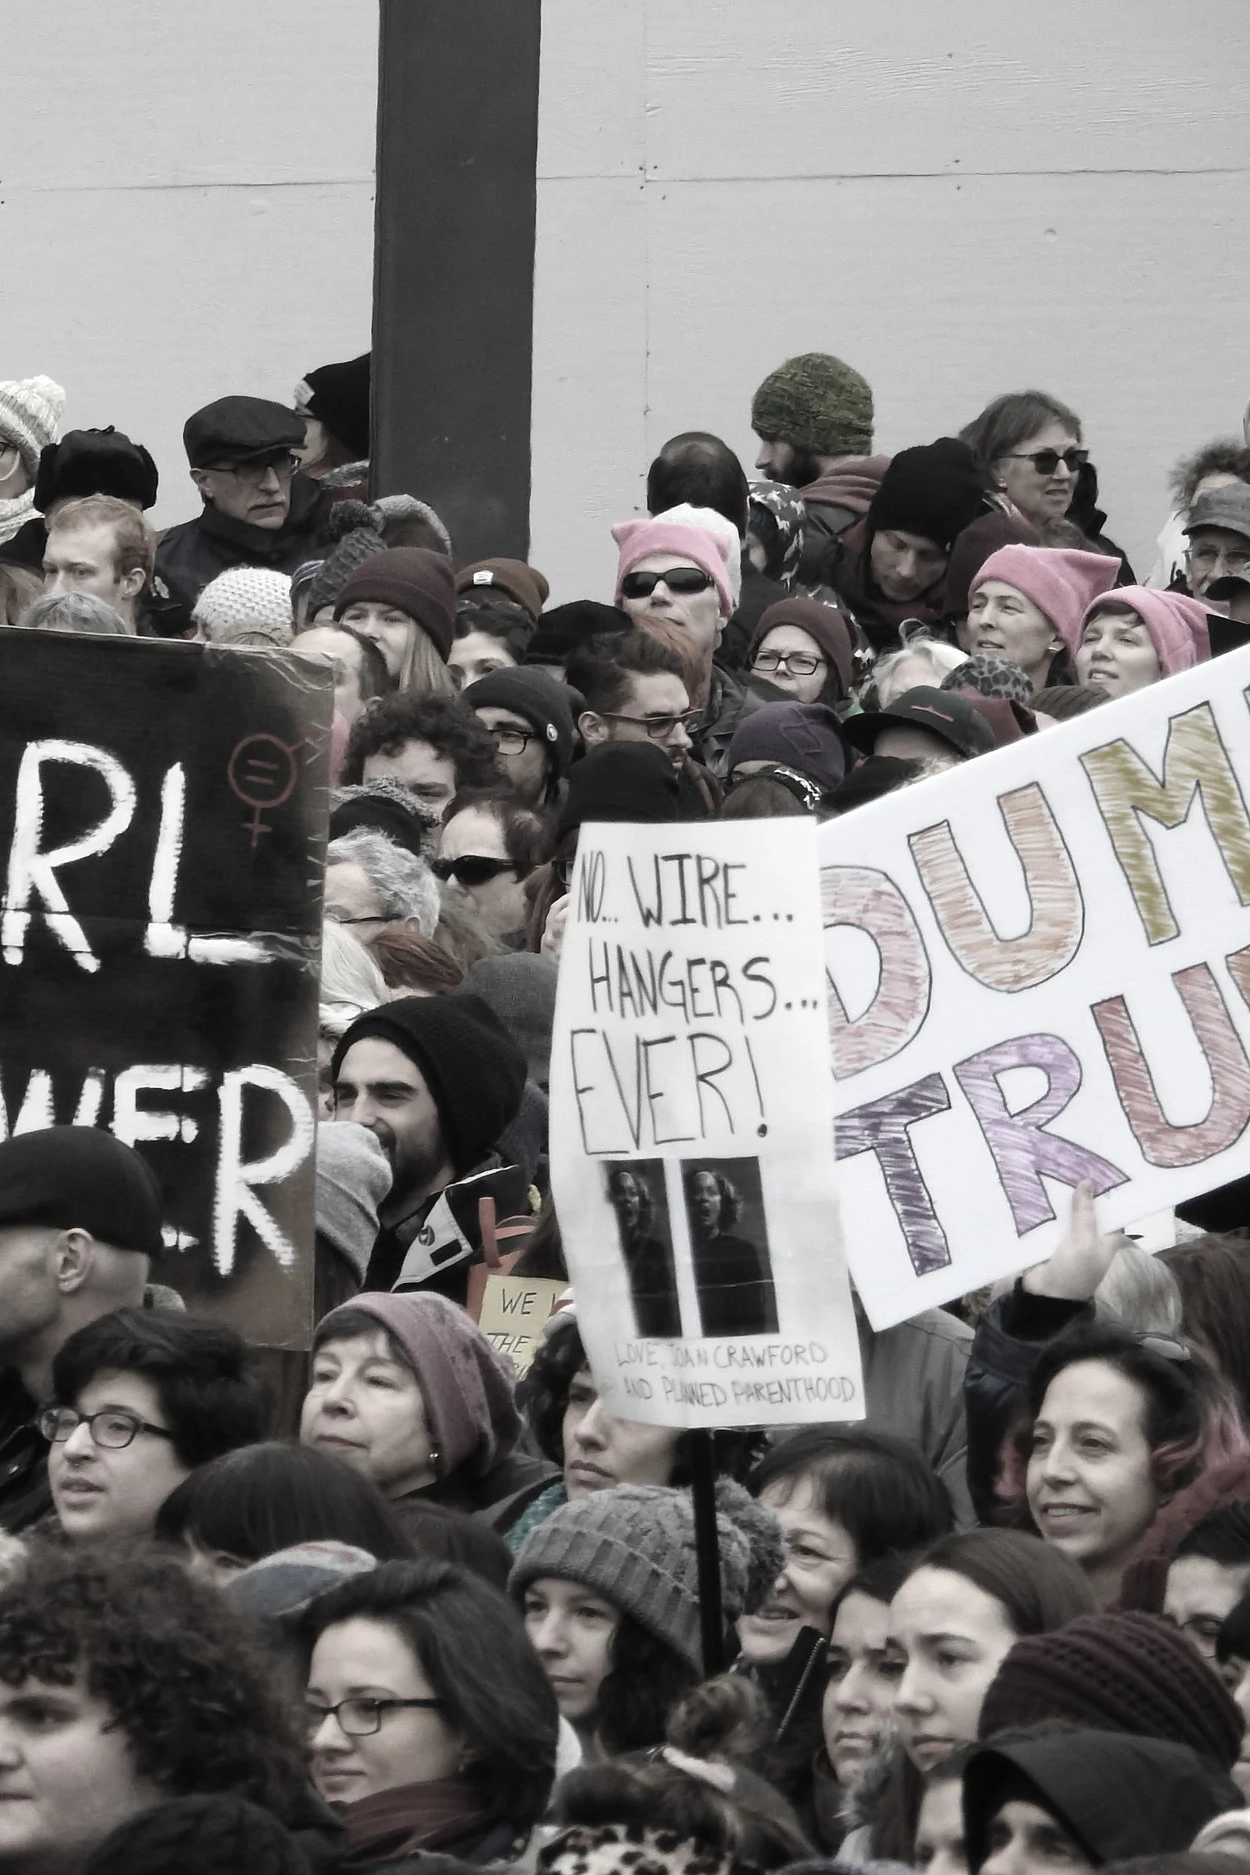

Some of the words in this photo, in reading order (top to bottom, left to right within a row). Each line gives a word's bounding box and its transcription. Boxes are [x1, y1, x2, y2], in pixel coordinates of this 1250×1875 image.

[627, 853, 793, 929] WIRE...
[819, 684, 1250, 1081] DUM
[588, 937, 818, 1025] HANGERS...
[571, 1029, 768, 1154] EVER!
[833, 944, 1250, 1275] TRU
[502, 1288, 537, 1314] WE
[487, 1333, 531, 1353] THE
[713, 1341, 828, 1369] CRAWFORD
[732, 1377, 855, 1406] PARENTHOOD
